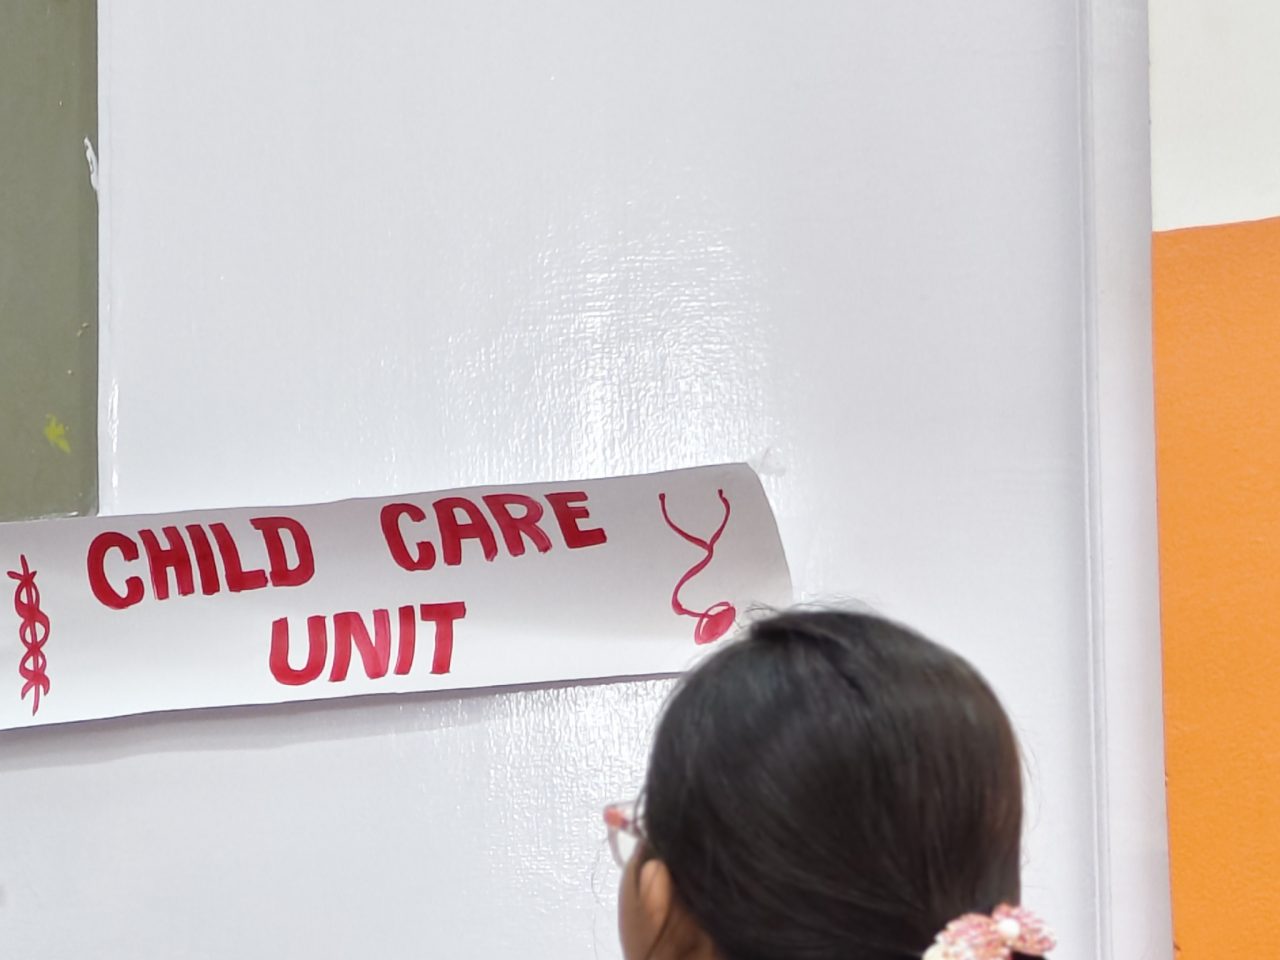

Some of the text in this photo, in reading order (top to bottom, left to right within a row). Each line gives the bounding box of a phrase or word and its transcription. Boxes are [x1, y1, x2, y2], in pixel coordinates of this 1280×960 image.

[87, 491, 607, 610] CHILD CARE
[270, 601, 466, 686] UNIT
